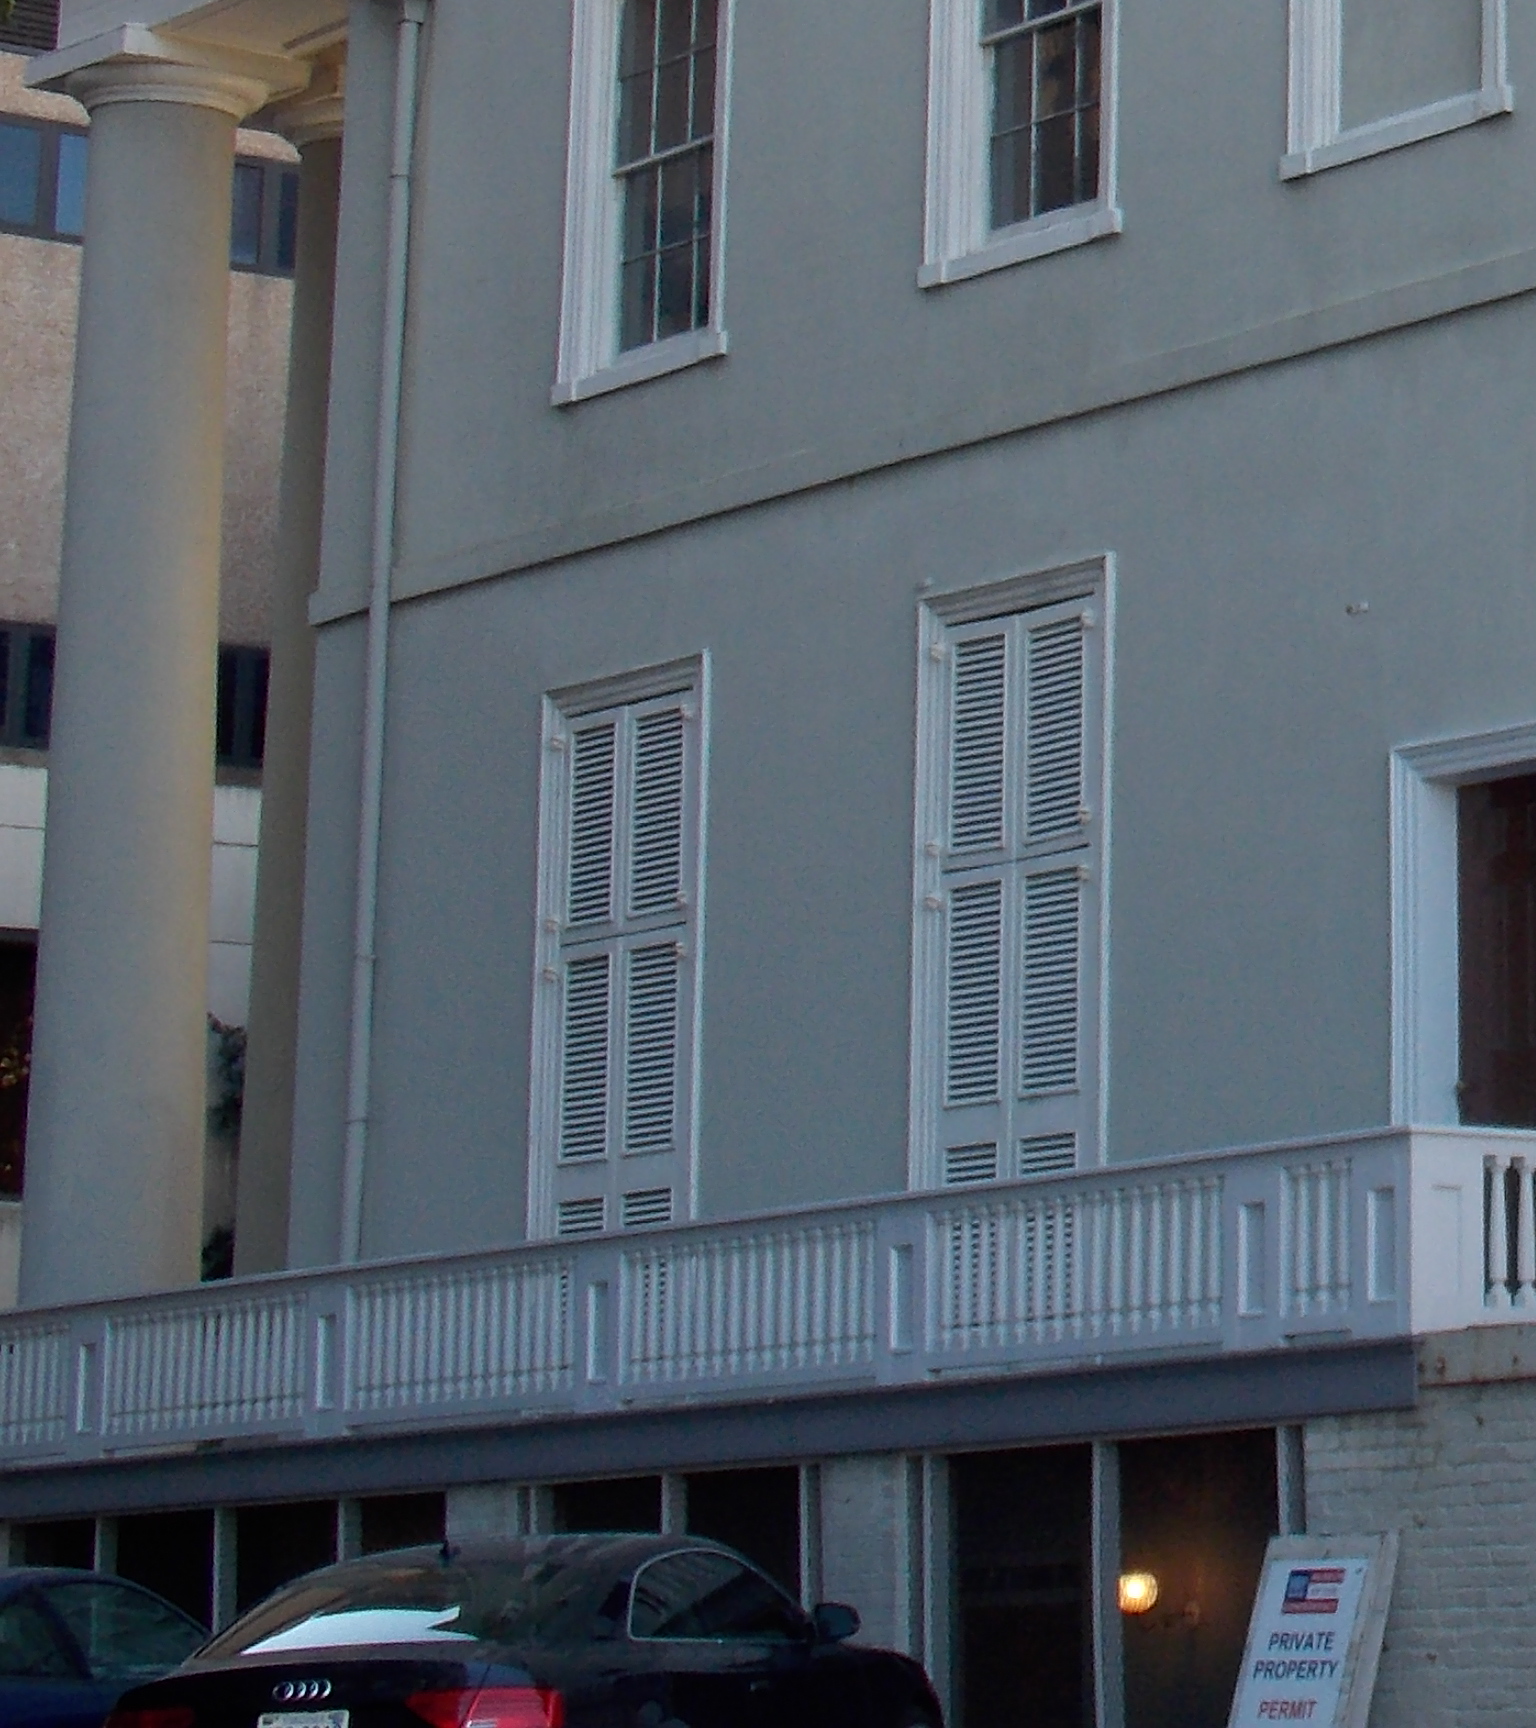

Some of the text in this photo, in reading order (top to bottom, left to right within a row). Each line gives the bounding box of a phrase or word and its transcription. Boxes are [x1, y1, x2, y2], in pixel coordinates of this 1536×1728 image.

[1268, 1632, 1335, 1651] PRIVATE
[1252, 1659, 1339, 1679] PROPERTY
[1257, 1699, 1317, 1720] PERMIT
